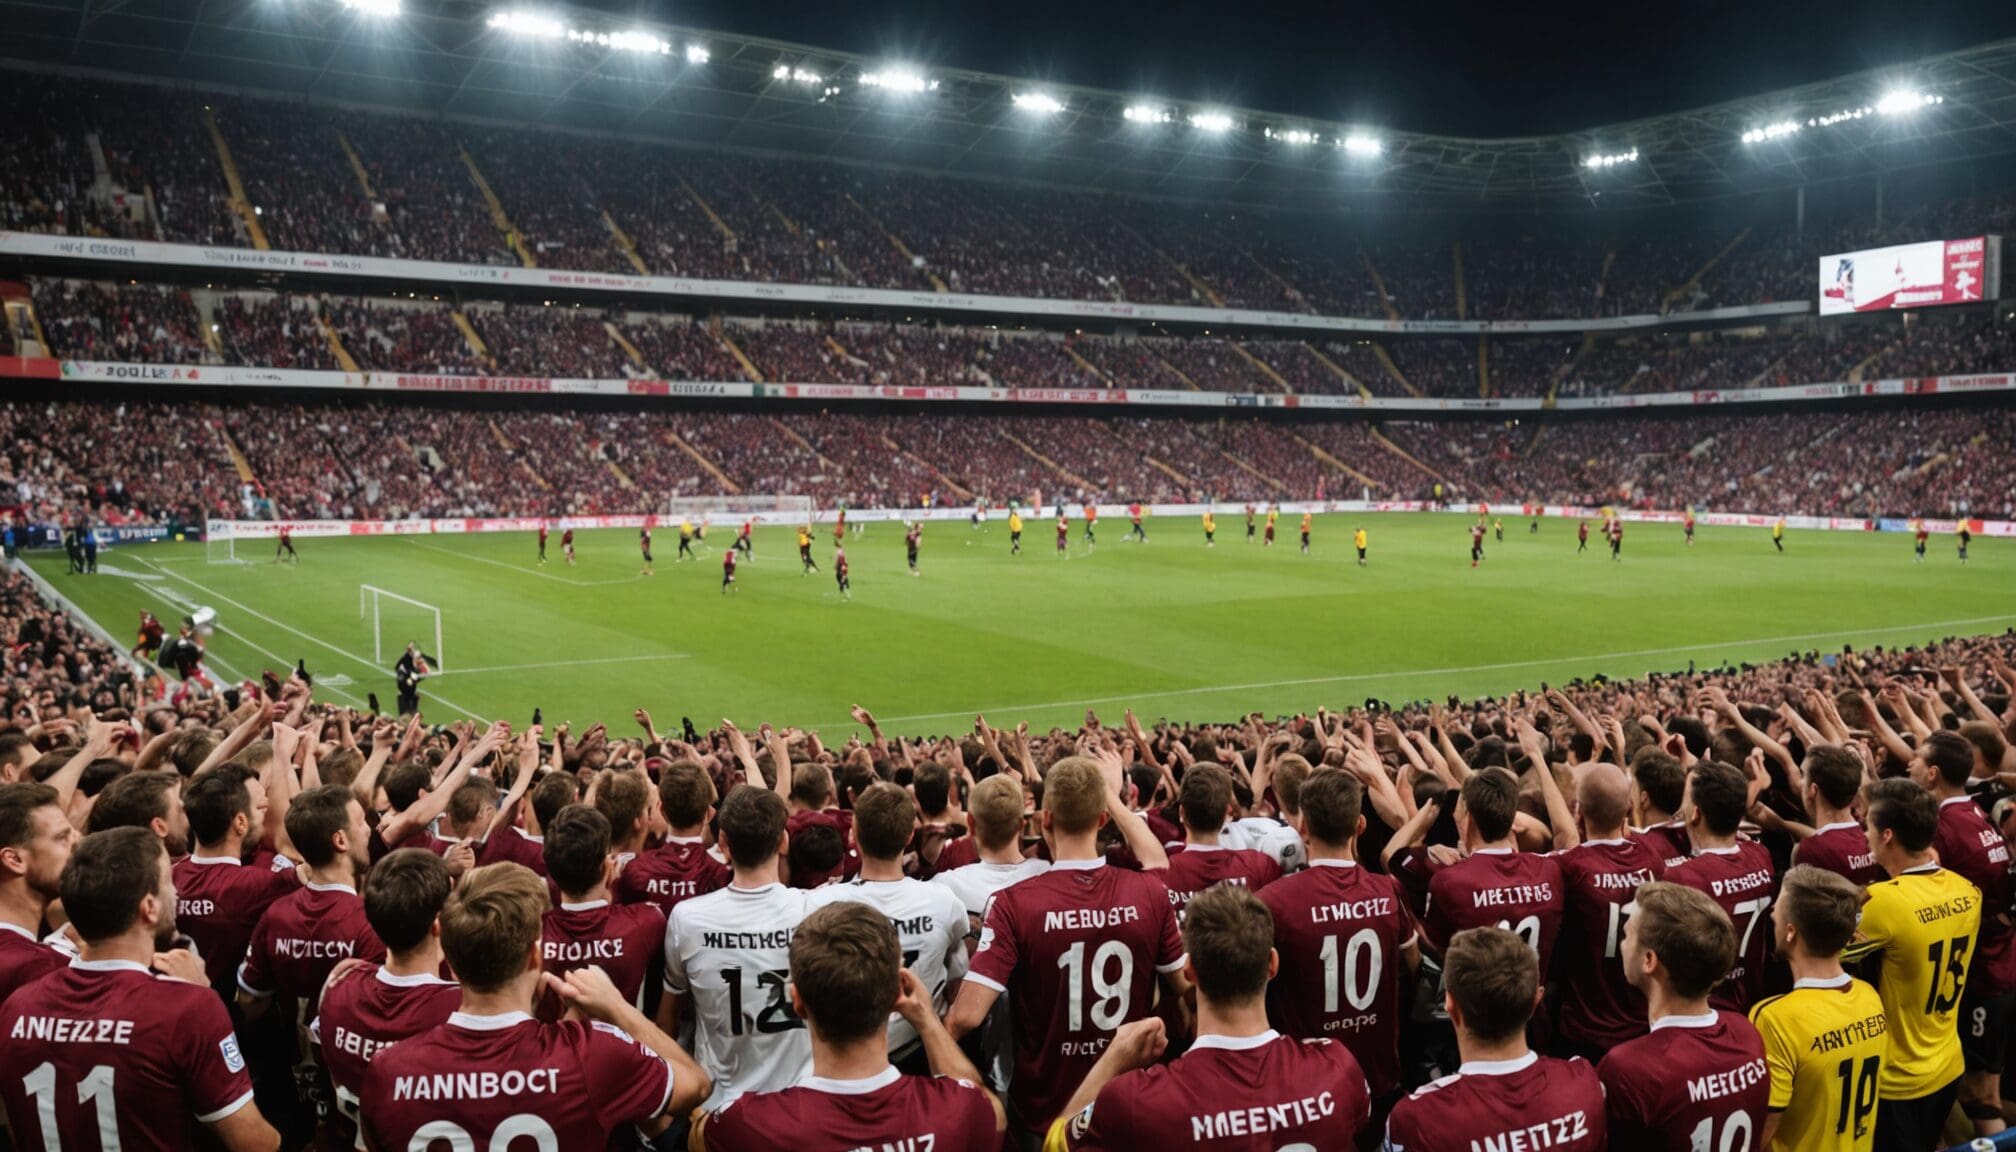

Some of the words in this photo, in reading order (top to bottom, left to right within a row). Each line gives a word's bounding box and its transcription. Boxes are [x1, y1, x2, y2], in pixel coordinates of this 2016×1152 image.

[1733, 895, 1772, 958] 7
[1319, 928, 1382, 1013] 10
[22, 1062, 122, 1152] 11
